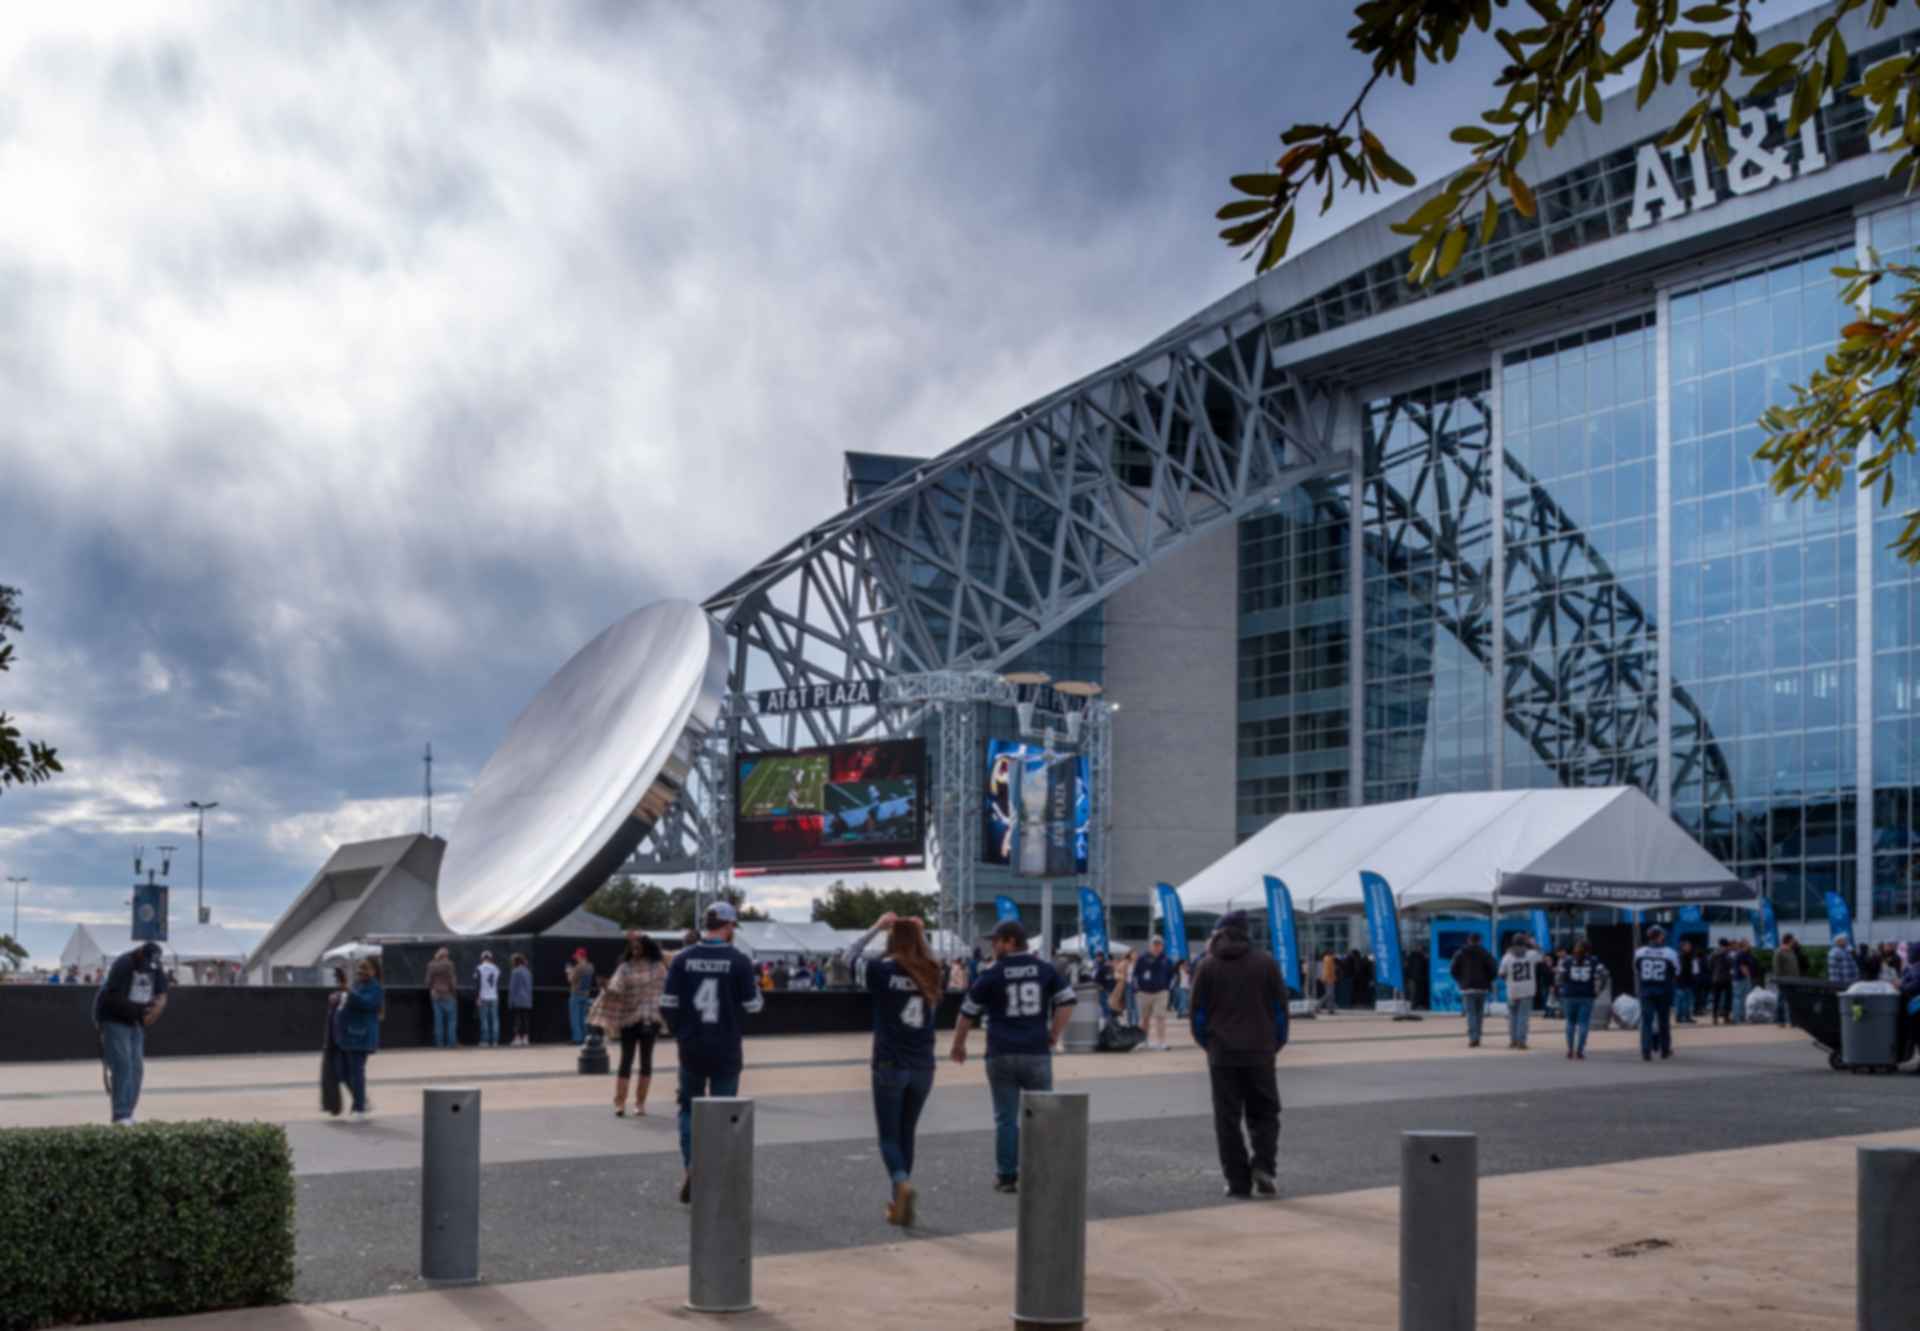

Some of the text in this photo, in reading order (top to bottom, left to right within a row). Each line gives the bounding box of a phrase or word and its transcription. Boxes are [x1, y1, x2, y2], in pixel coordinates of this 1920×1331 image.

[1627, 87, 1833, 230] AT&T
[767, 682, 870, 712] AT&T PLAZA
[1512, 961, 1531, 981] 21
[1641, 959, 1666, 981] 82
[693, 978, 719, 1023] 4
[900, 996, 924, 1028] 4
[1005, 981, 1041, 1017] 19
